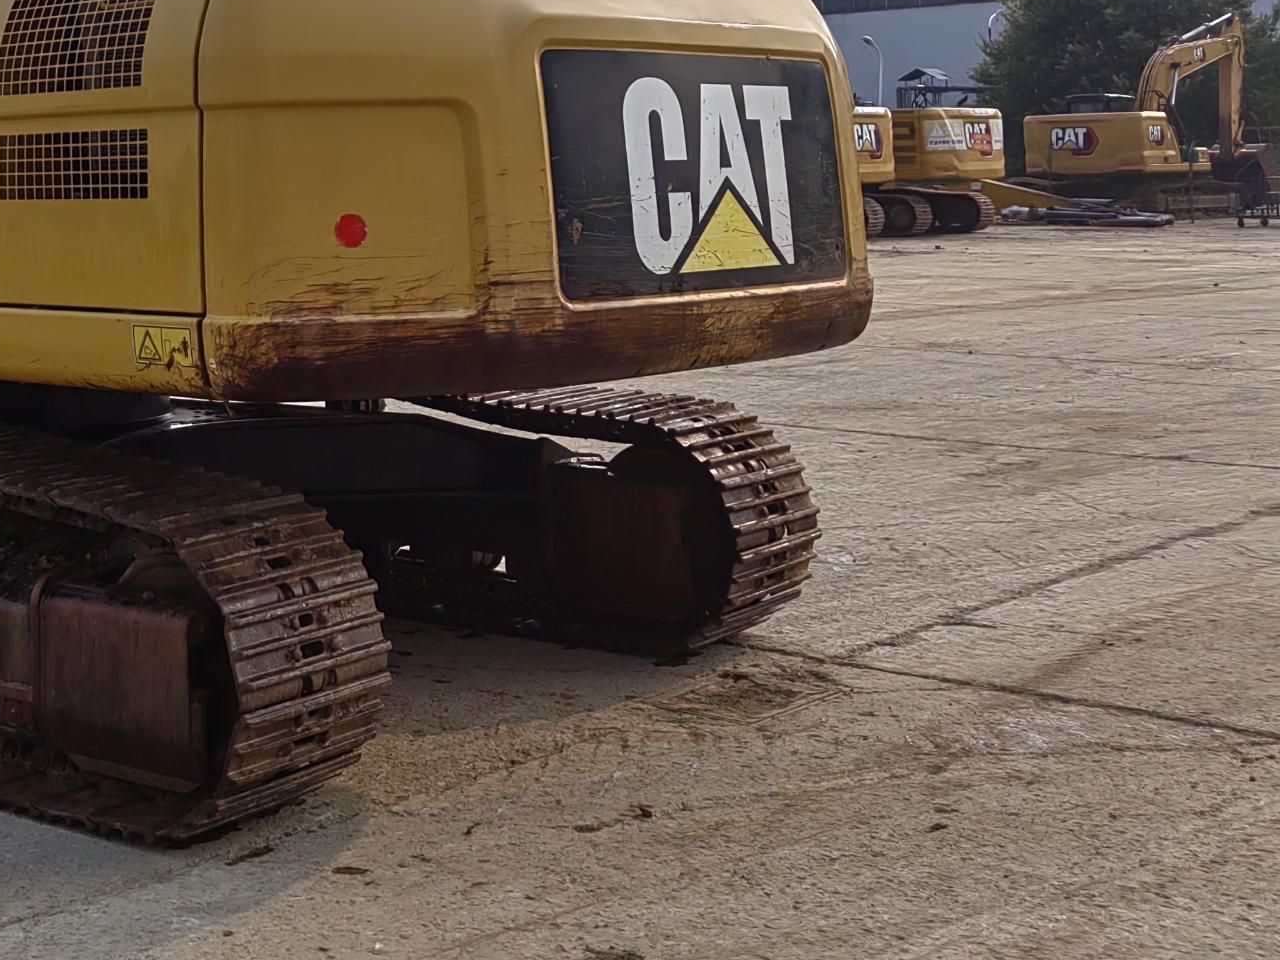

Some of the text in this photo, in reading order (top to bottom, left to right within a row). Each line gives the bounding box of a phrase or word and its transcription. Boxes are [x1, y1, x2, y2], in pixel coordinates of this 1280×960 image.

[853, 123, 877, 152] CAT
[1051, 127, 1087, 150] CAT
[1148, 125, 1161, 141] CAT
[623, 76, 795, 275] CAT
